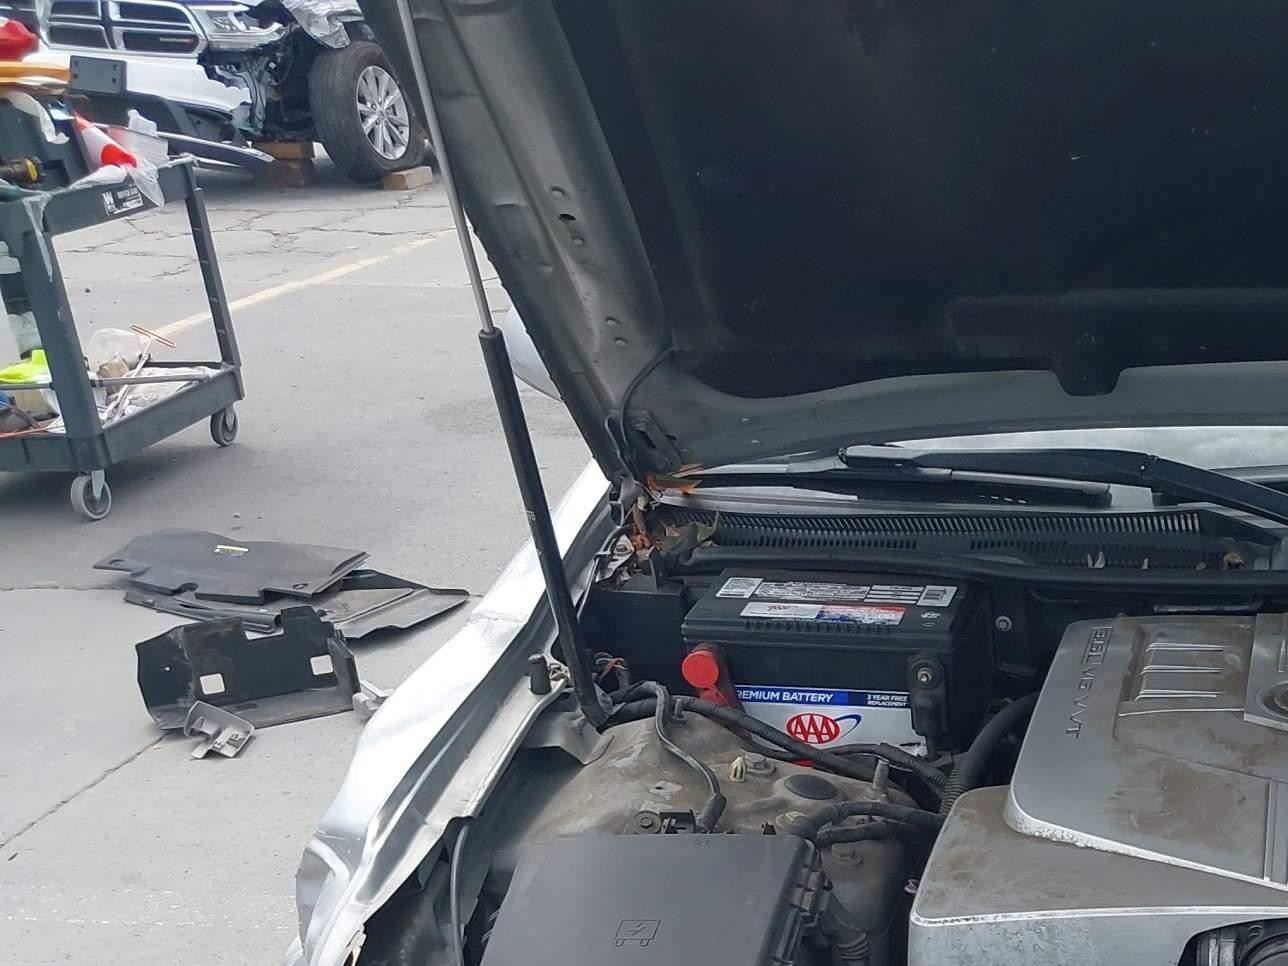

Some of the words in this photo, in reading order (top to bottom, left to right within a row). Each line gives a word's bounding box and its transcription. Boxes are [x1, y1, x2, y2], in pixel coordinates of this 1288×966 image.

[736, 690, 781, 701] REMIUM
[783, 692, 834, 703] BATTERY
[793, 713, 836, 743] AAA
[1066, 695, 1089, 739] VVT
